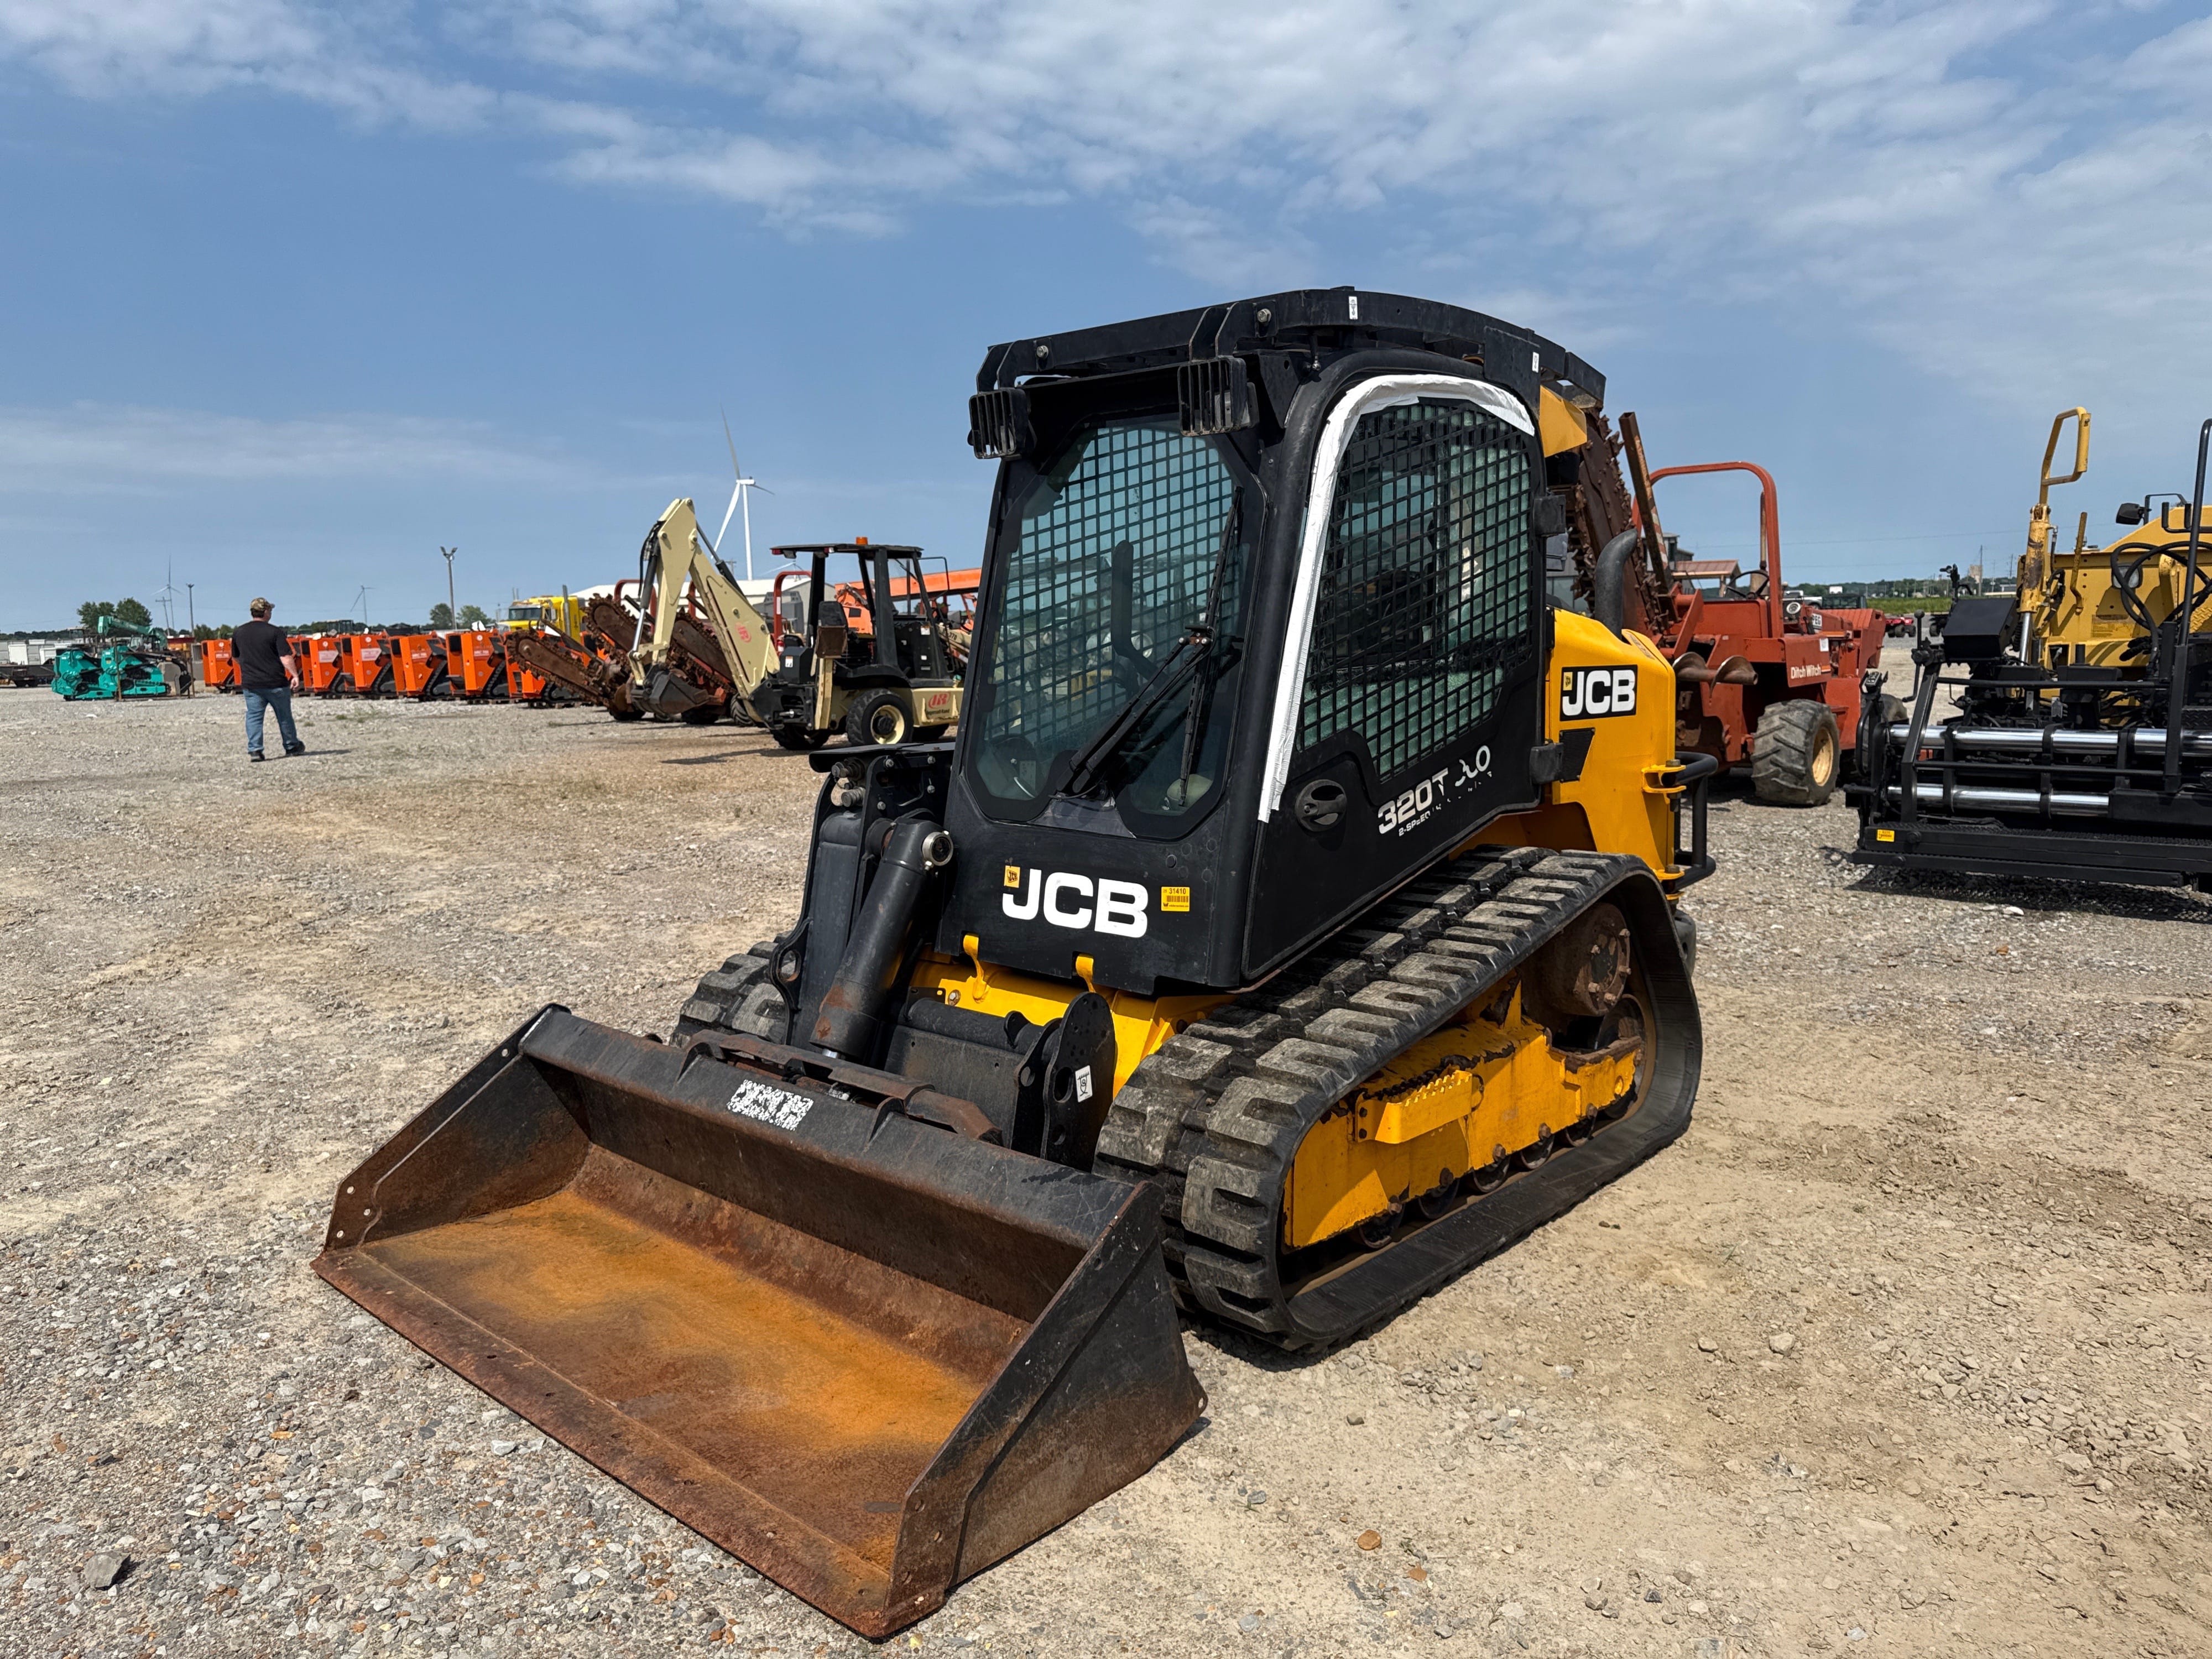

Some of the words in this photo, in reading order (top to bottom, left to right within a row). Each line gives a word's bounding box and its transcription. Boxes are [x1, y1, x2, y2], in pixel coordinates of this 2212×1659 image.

[1562, 670, 1636, 716] JCB
[1791, 665, 1806, 679] Ditch
[1806, 664, 1822, 677] Witch
[1002, 868, 1149, 938] JCB
